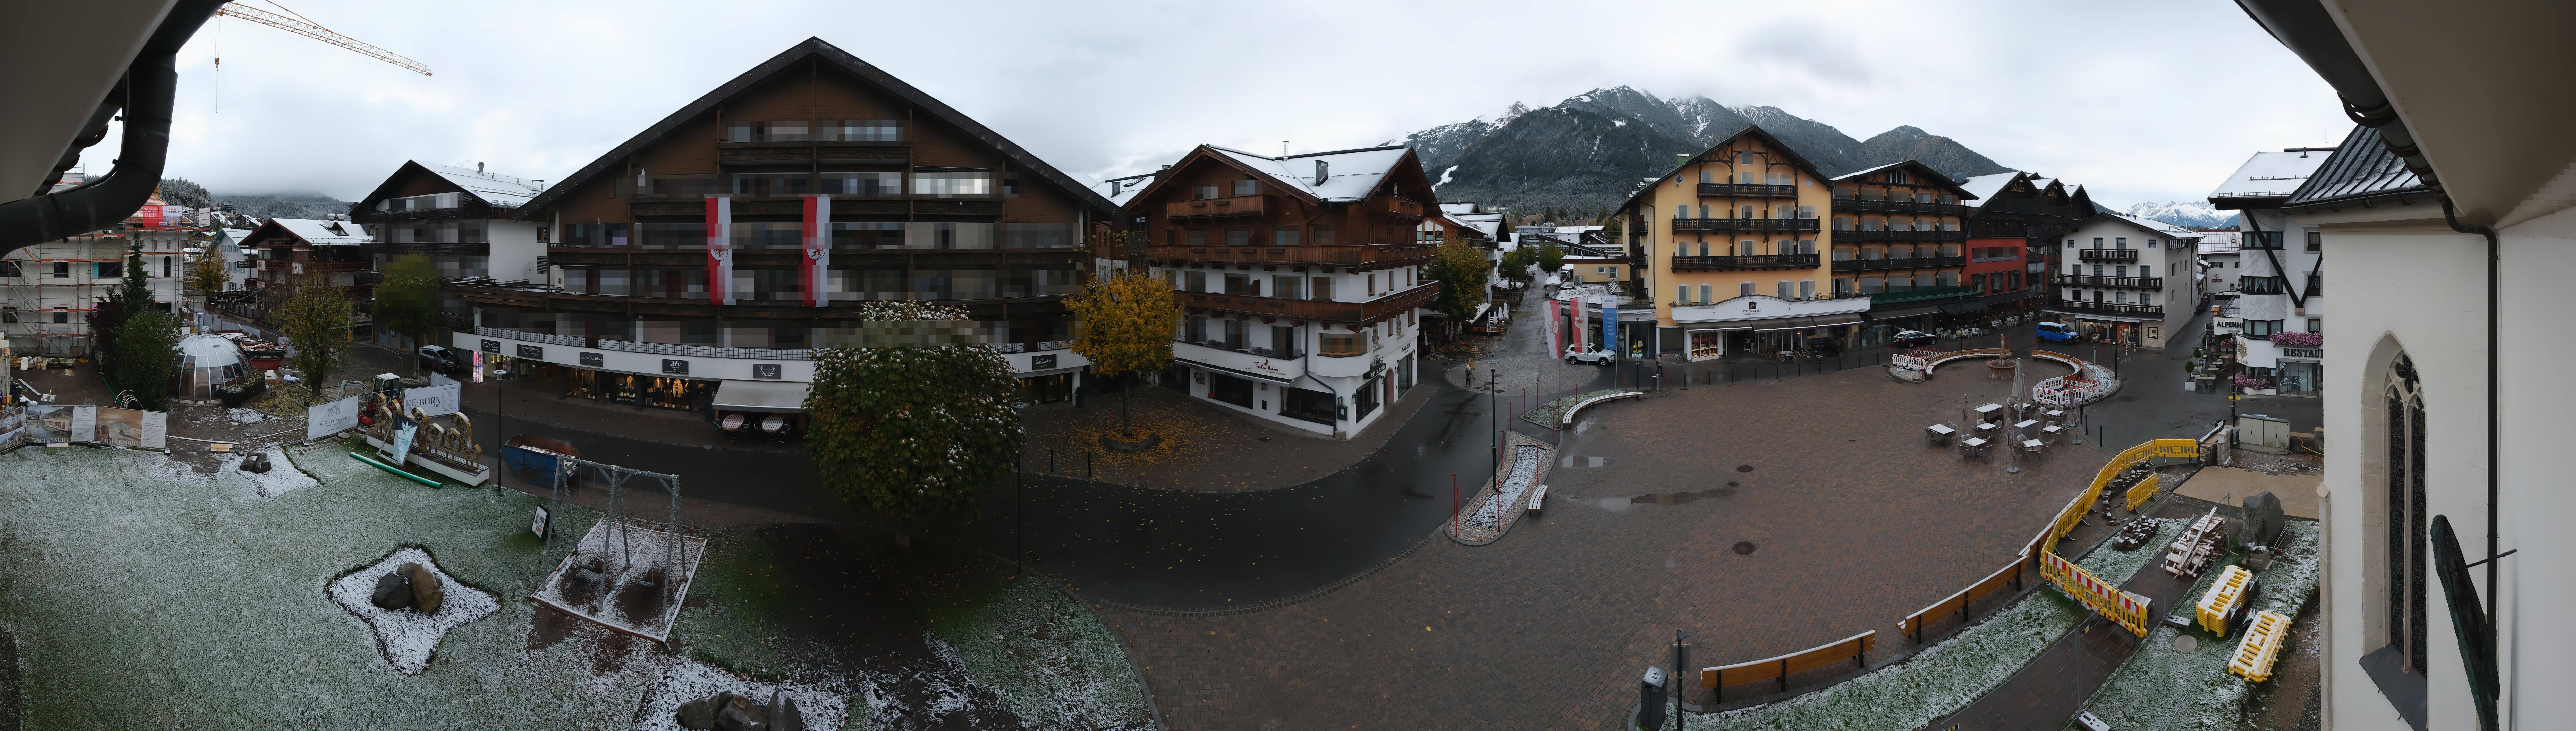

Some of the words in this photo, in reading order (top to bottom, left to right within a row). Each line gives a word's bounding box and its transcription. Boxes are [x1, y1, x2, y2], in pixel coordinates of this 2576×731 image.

[1402, 343, 1410, 352] SAILER
[1371, 365, 1385, 377] RESTAURANT
[320, 416, 347, 426] KLOSTERBRÄU
